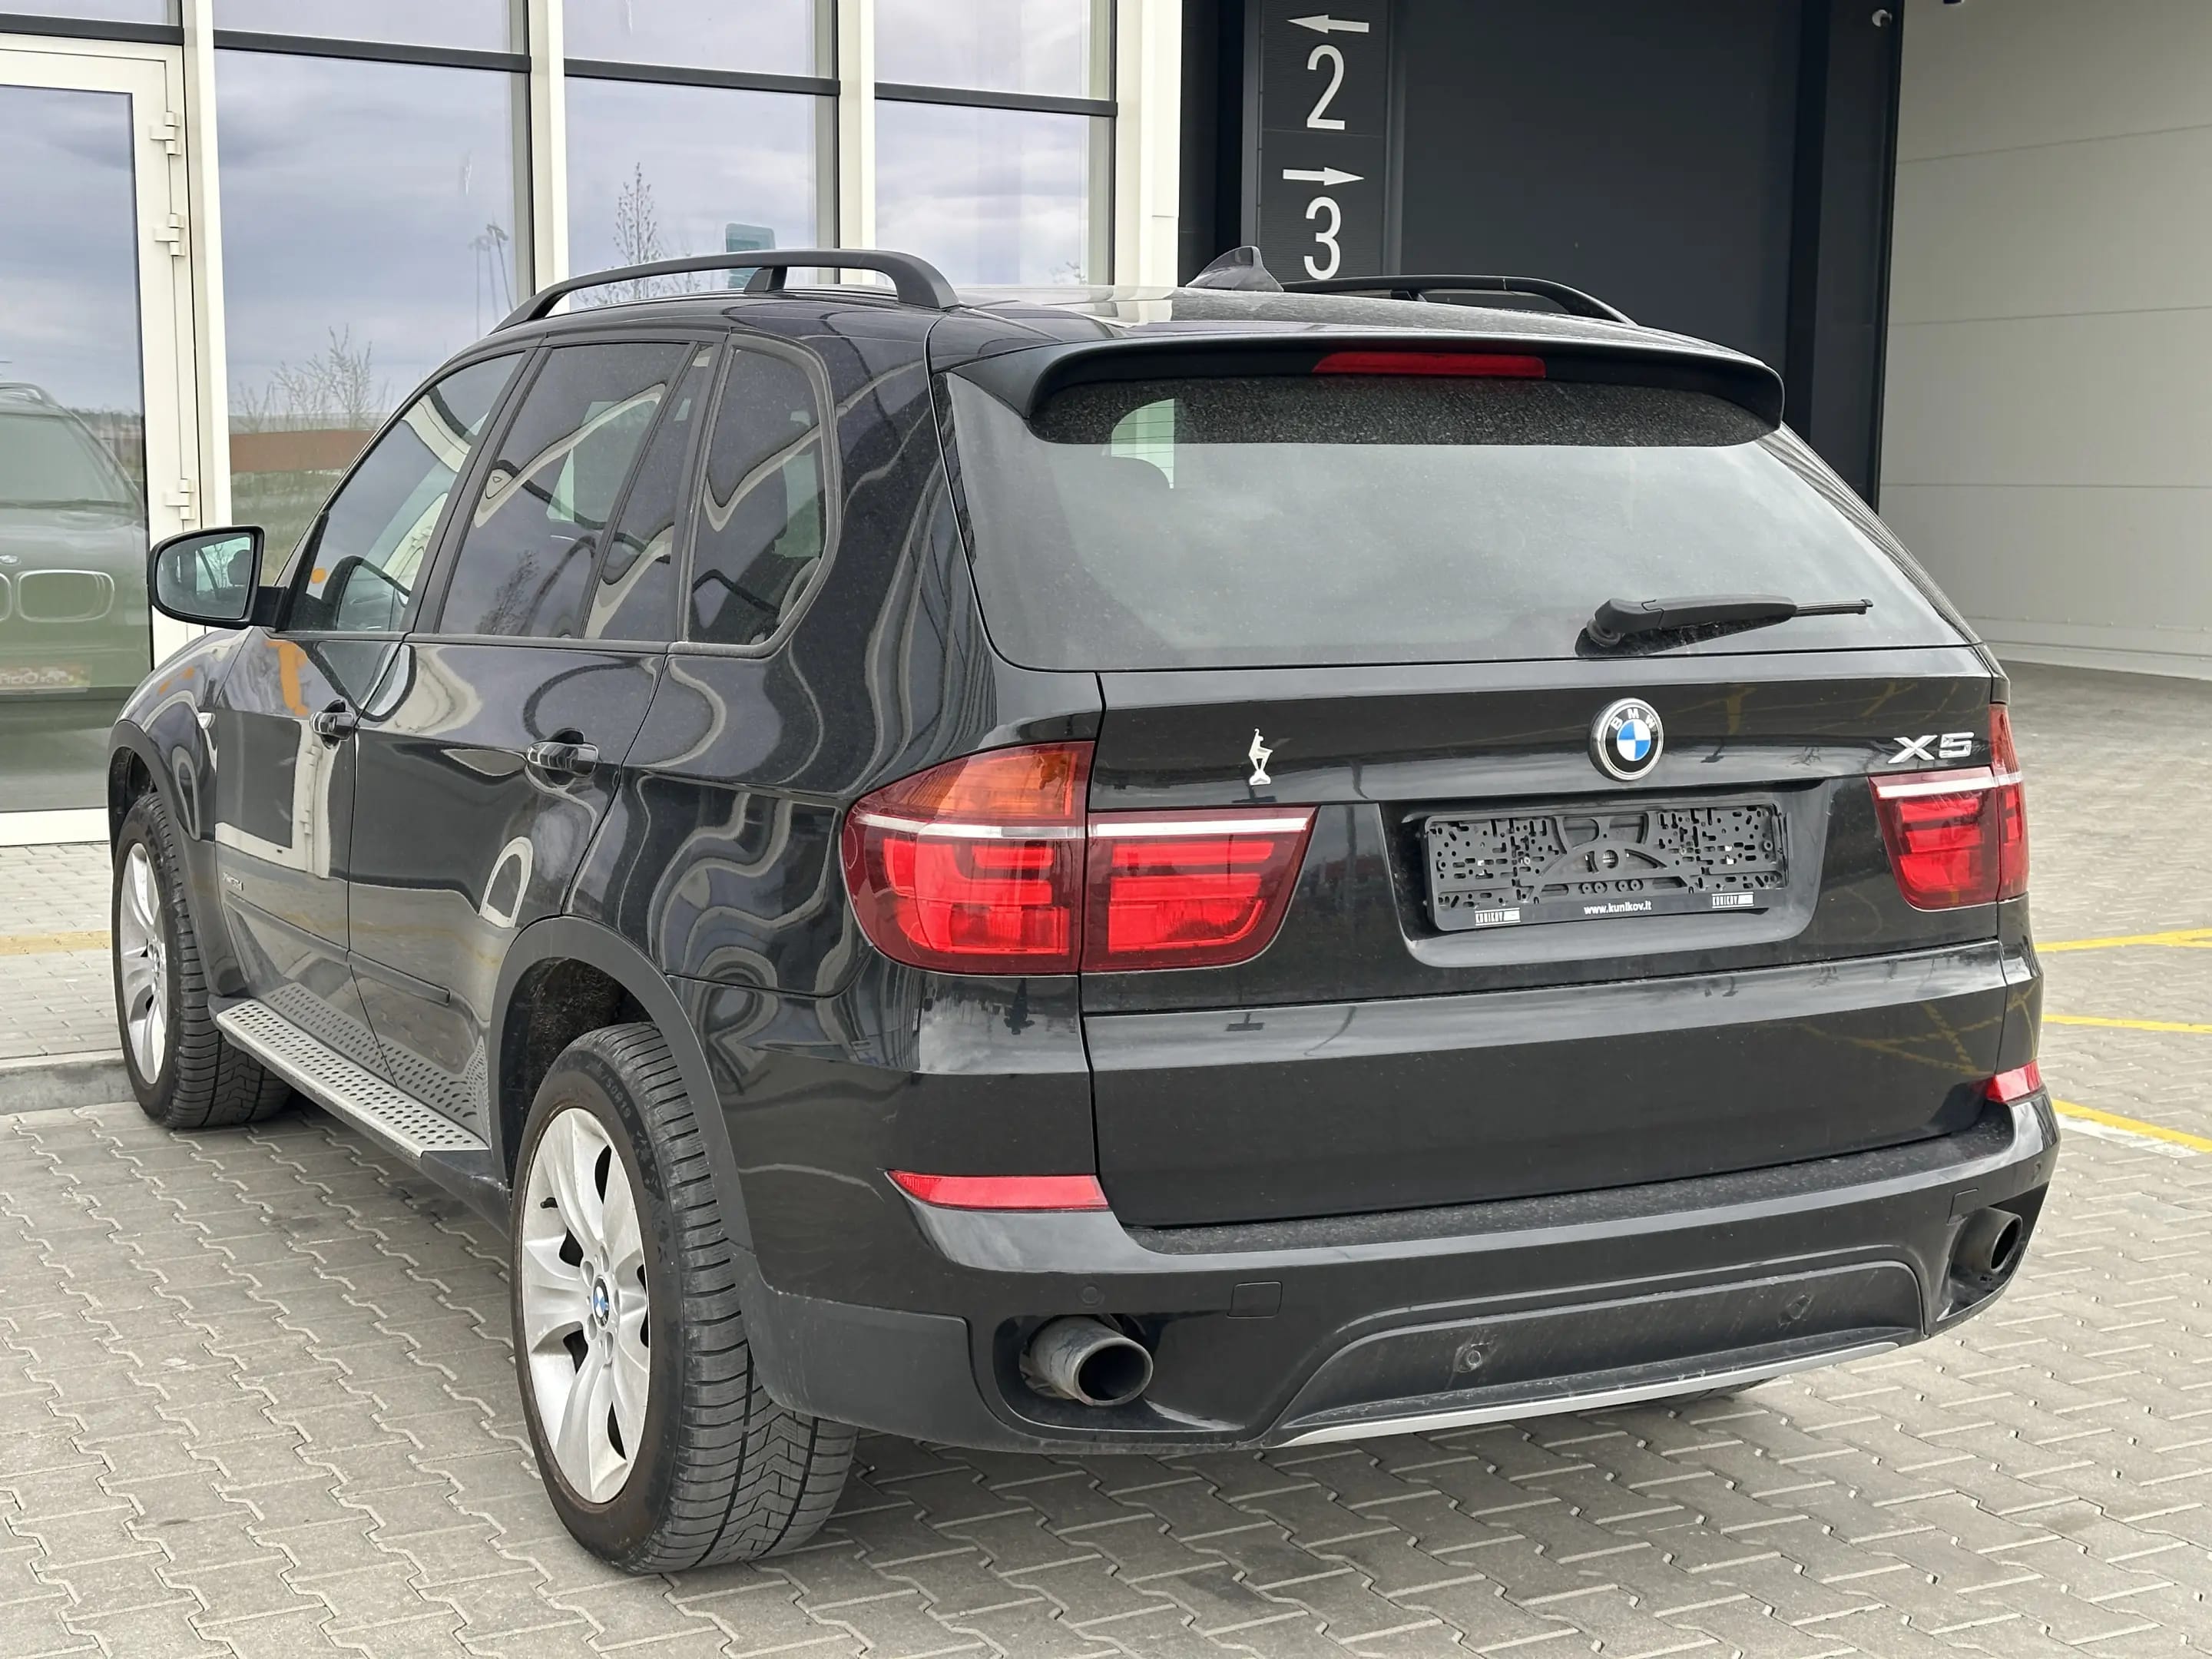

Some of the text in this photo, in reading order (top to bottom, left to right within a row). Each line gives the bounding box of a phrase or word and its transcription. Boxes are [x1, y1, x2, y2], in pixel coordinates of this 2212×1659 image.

[1306, 45, 1345, 130] 2
[1304, 196, 1342, 280] 3
[1611, 708, 1655, 730] BMW
[1888, 732, 1975, 763] X5
